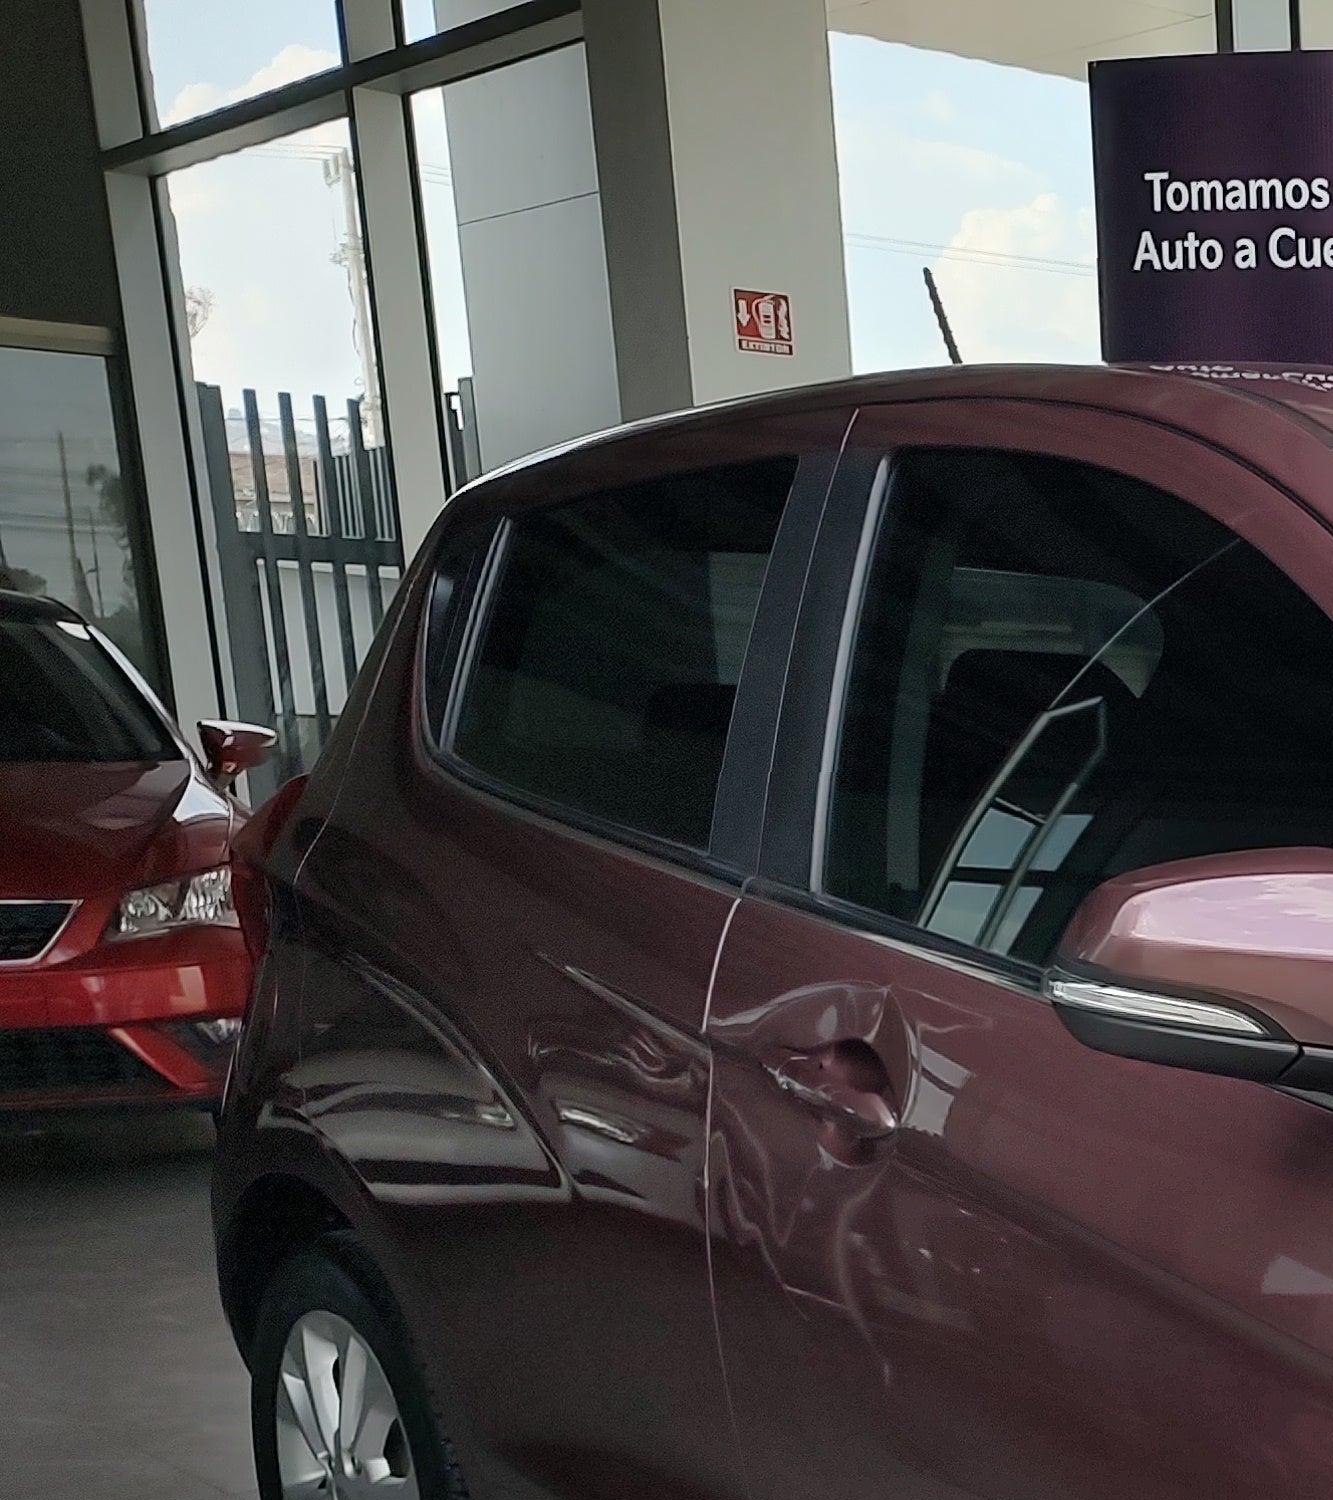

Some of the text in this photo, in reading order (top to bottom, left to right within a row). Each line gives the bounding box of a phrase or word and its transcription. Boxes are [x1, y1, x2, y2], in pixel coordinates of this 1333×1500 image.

[1144, 170, 1330, 212] Tomamos
[1132, 230, 1223, 271] Auto
[1234, 236, 1257, 269] a
